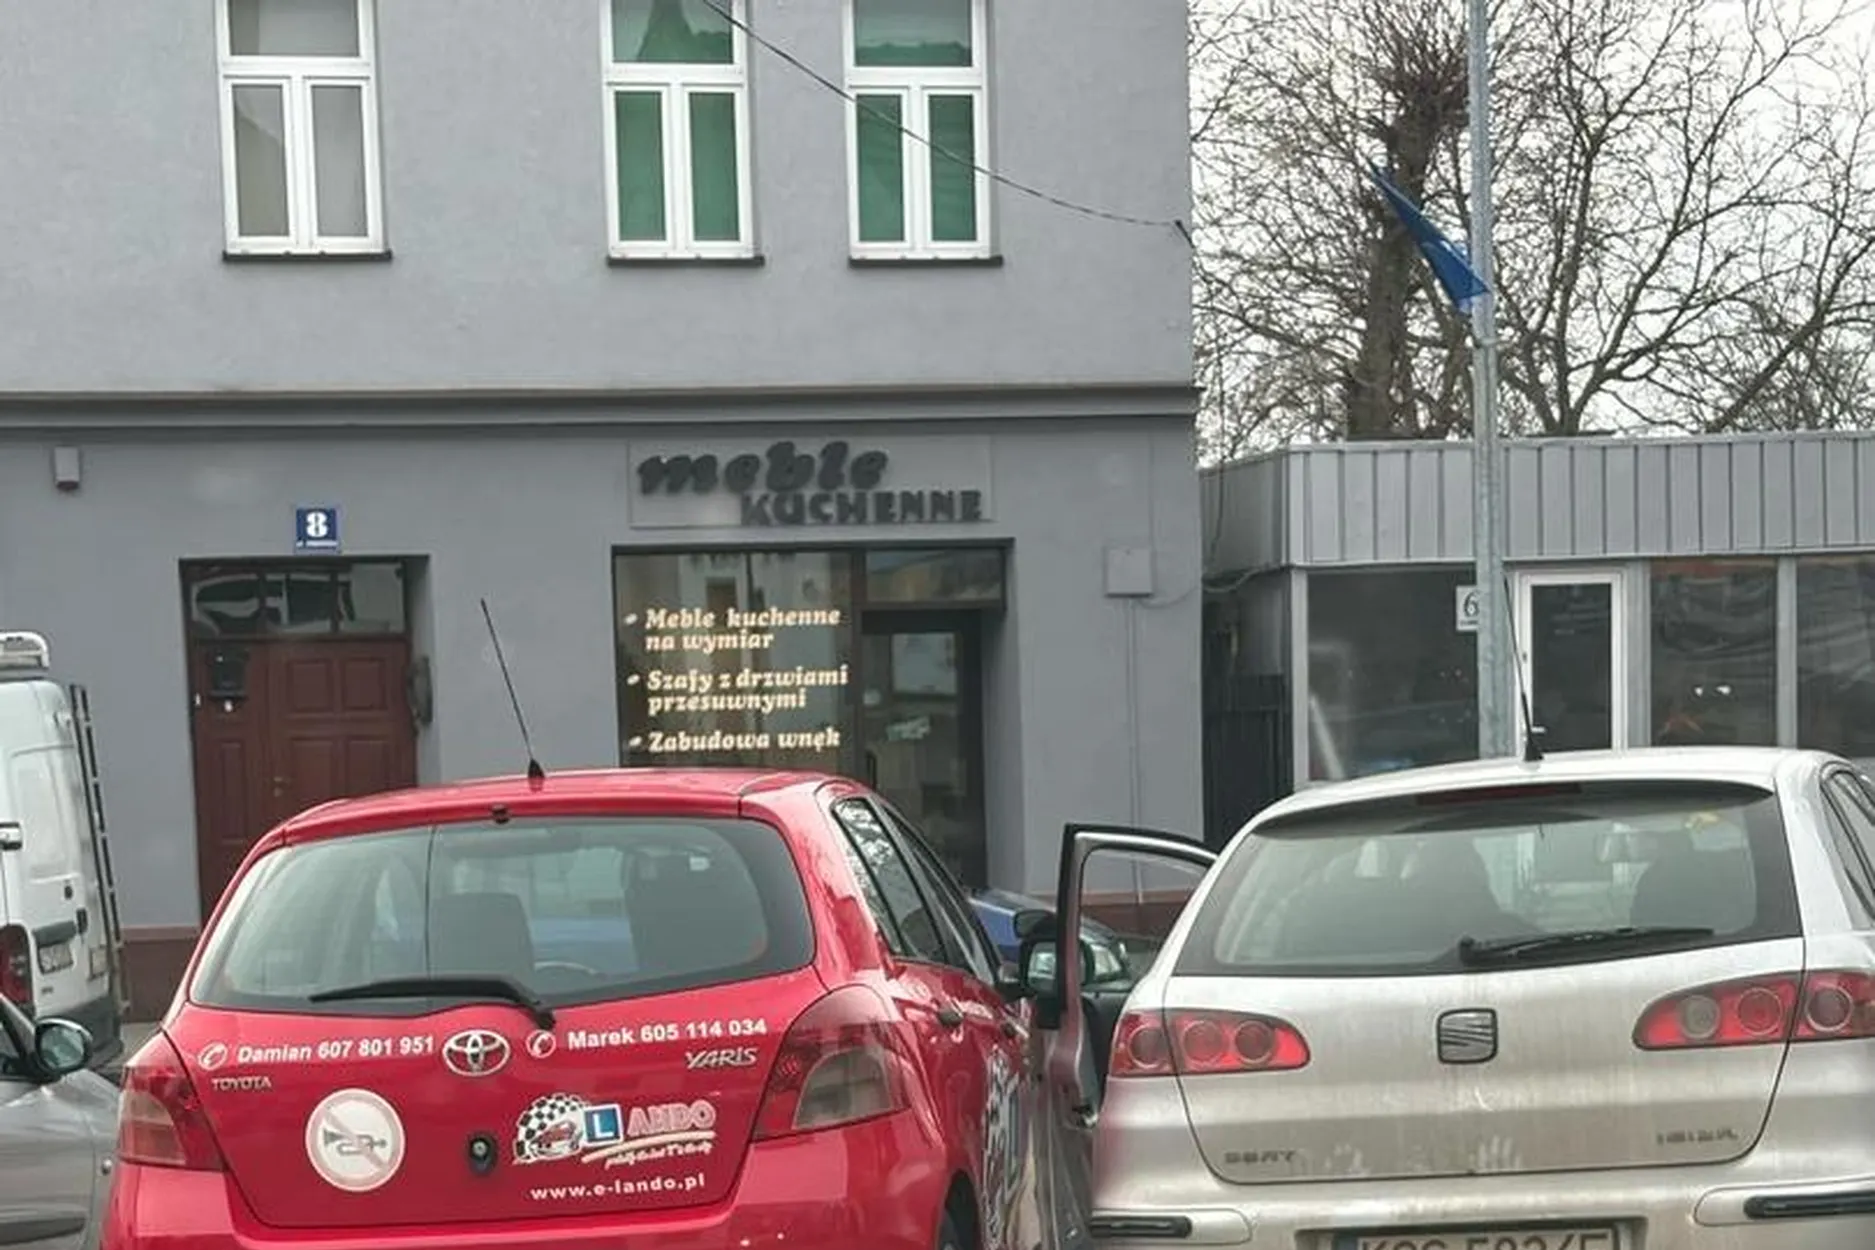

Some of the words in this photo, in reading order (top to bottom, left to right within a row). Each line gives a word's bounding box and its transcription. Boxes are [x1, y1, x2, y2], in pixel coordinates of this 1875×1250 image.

[637, 440, 889, 496] meble
[740, 488, 983, 526] KUCHENNE
[306, 511, 328, 538] 8
[645, 608, 716, 630] Meble
[726, 606, 841, 628] kuchenne
[645, 634, 676, 651] na
[681, 628, 775, 655] wymiar
[647, 668, 714, 694] Szafy
[718, 674, 732, 690] z
[735, 663, 849, 690] drzwiami
[648, 687, 808, 717] przesuwnymi
[648, 730, 772, 753] Zabudowa
[777, 726, 842, 753] wnęk
[567, 1029, 635, 1050] Marek
[640, 1026, 679, 1043] 605
[686, 1021, 722, 1039] 114
[728, 1018, 768, 1036] 034
[237, 1045, 312, 1064] Damian
[317, 1041, 352, 1060] 607
[358, 1039, 392, 1057] 801
[399, 1035, 434, 1054] 951
[685, 1046, 758, 1069] YARIS
[211, 1076, 272, 1091] TOYOTA
[530, 1172, 706, 1200] www.e-lando.pl
